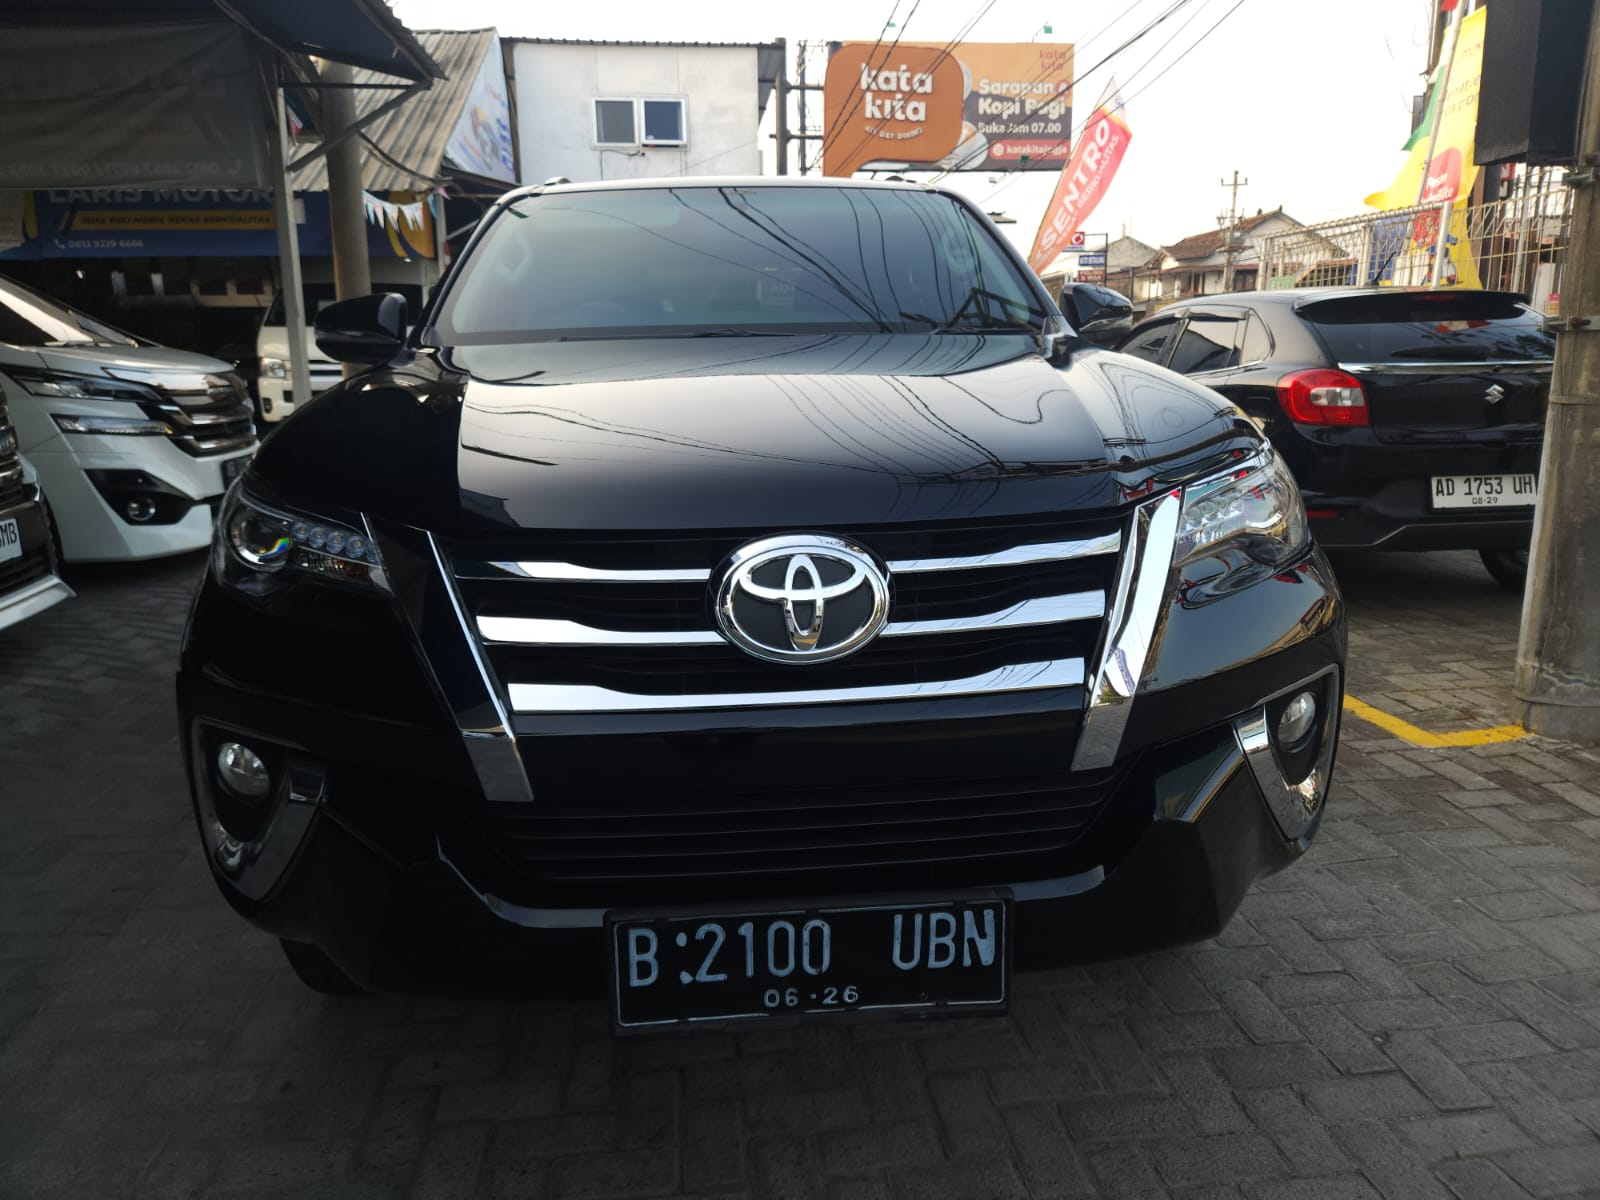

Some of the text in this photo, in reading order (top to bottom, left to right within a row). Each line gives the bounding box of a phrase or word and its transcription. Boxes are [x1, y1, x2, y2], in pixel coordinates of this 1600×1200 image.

[861, 63, 933, 93] kata
[978, 78, 1055, 102] Sarapan
[865, 91, 927, 121] kita
[978, 97, 1066, 120] Kopi Pagi
[1031, 121, 1062, 134] 07.00
[1041, 118, 1111, 247] SENTRO
[1435, 475, 1533, 497] AD 1753 UH
[0, 522, 18, 548] MB
[627, 909, 996, 988] B 2100 UBN
